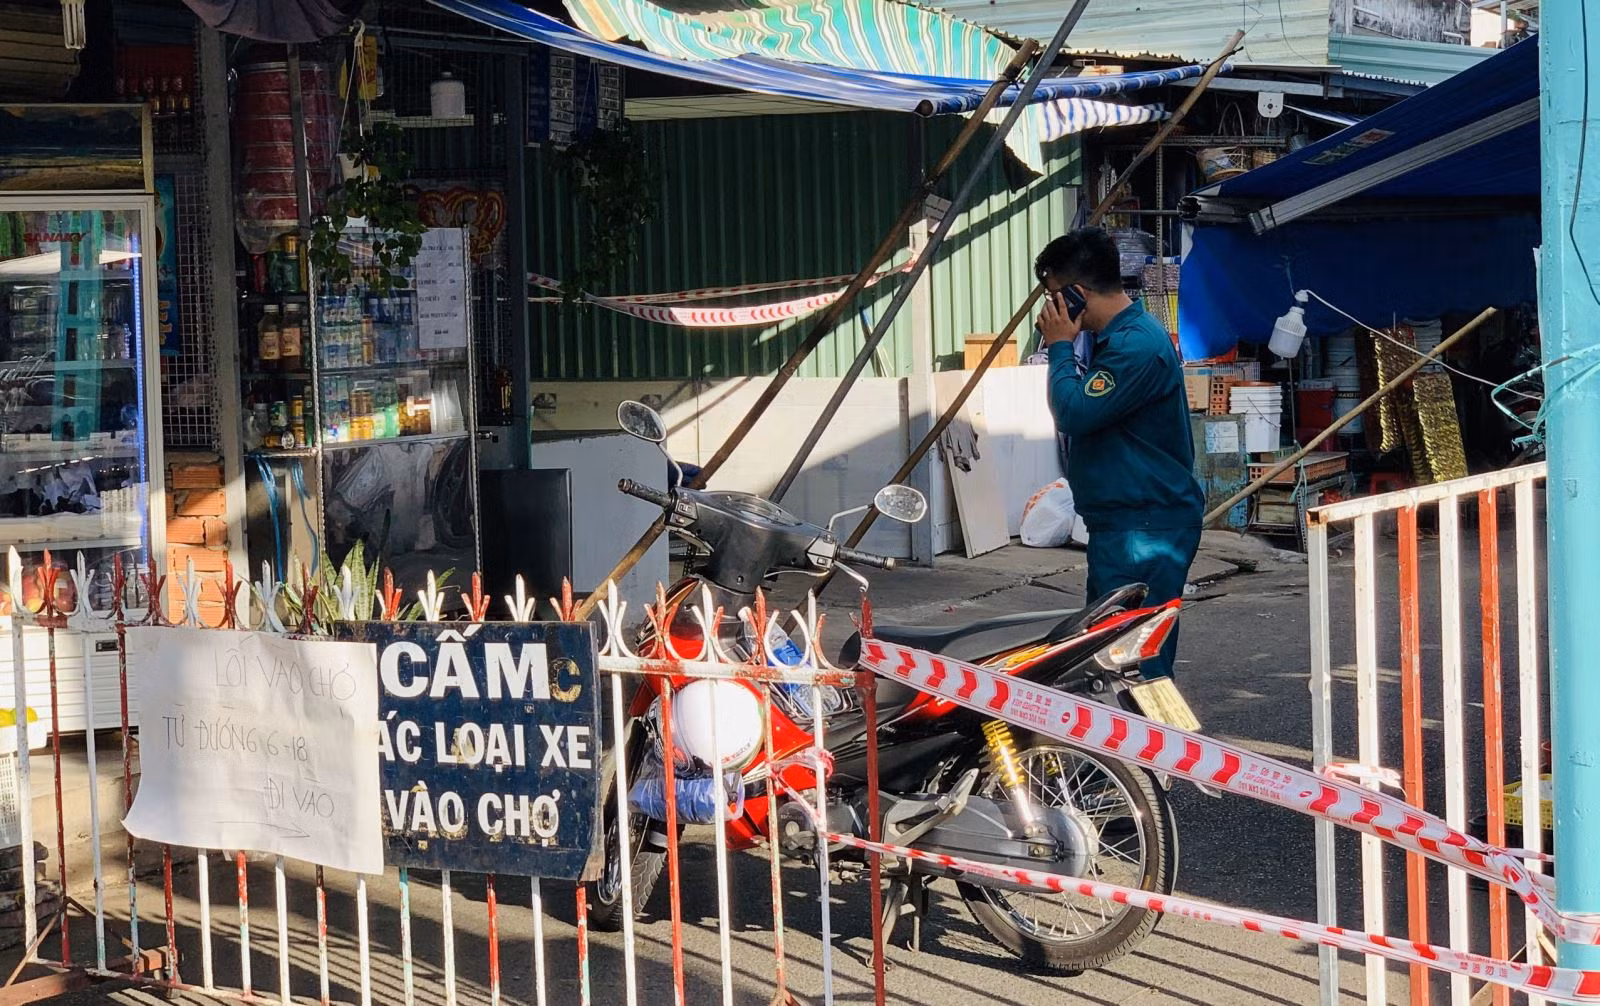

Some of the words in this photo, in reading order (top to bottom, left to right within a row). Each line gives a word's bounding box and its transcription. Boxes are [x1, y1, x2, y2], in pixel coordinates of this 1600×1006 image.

[379, 623, 551, 700] CẤM
[378, 710, 422, 762] ÁC
[435, 721, 526, 773] LOẠI
[539, 724, 592, 769] XE
[264, 777, 285, 810] ĐI
[385, 780, 465, 834] VÀO
[477, 789, 561, 847] CHỢ
